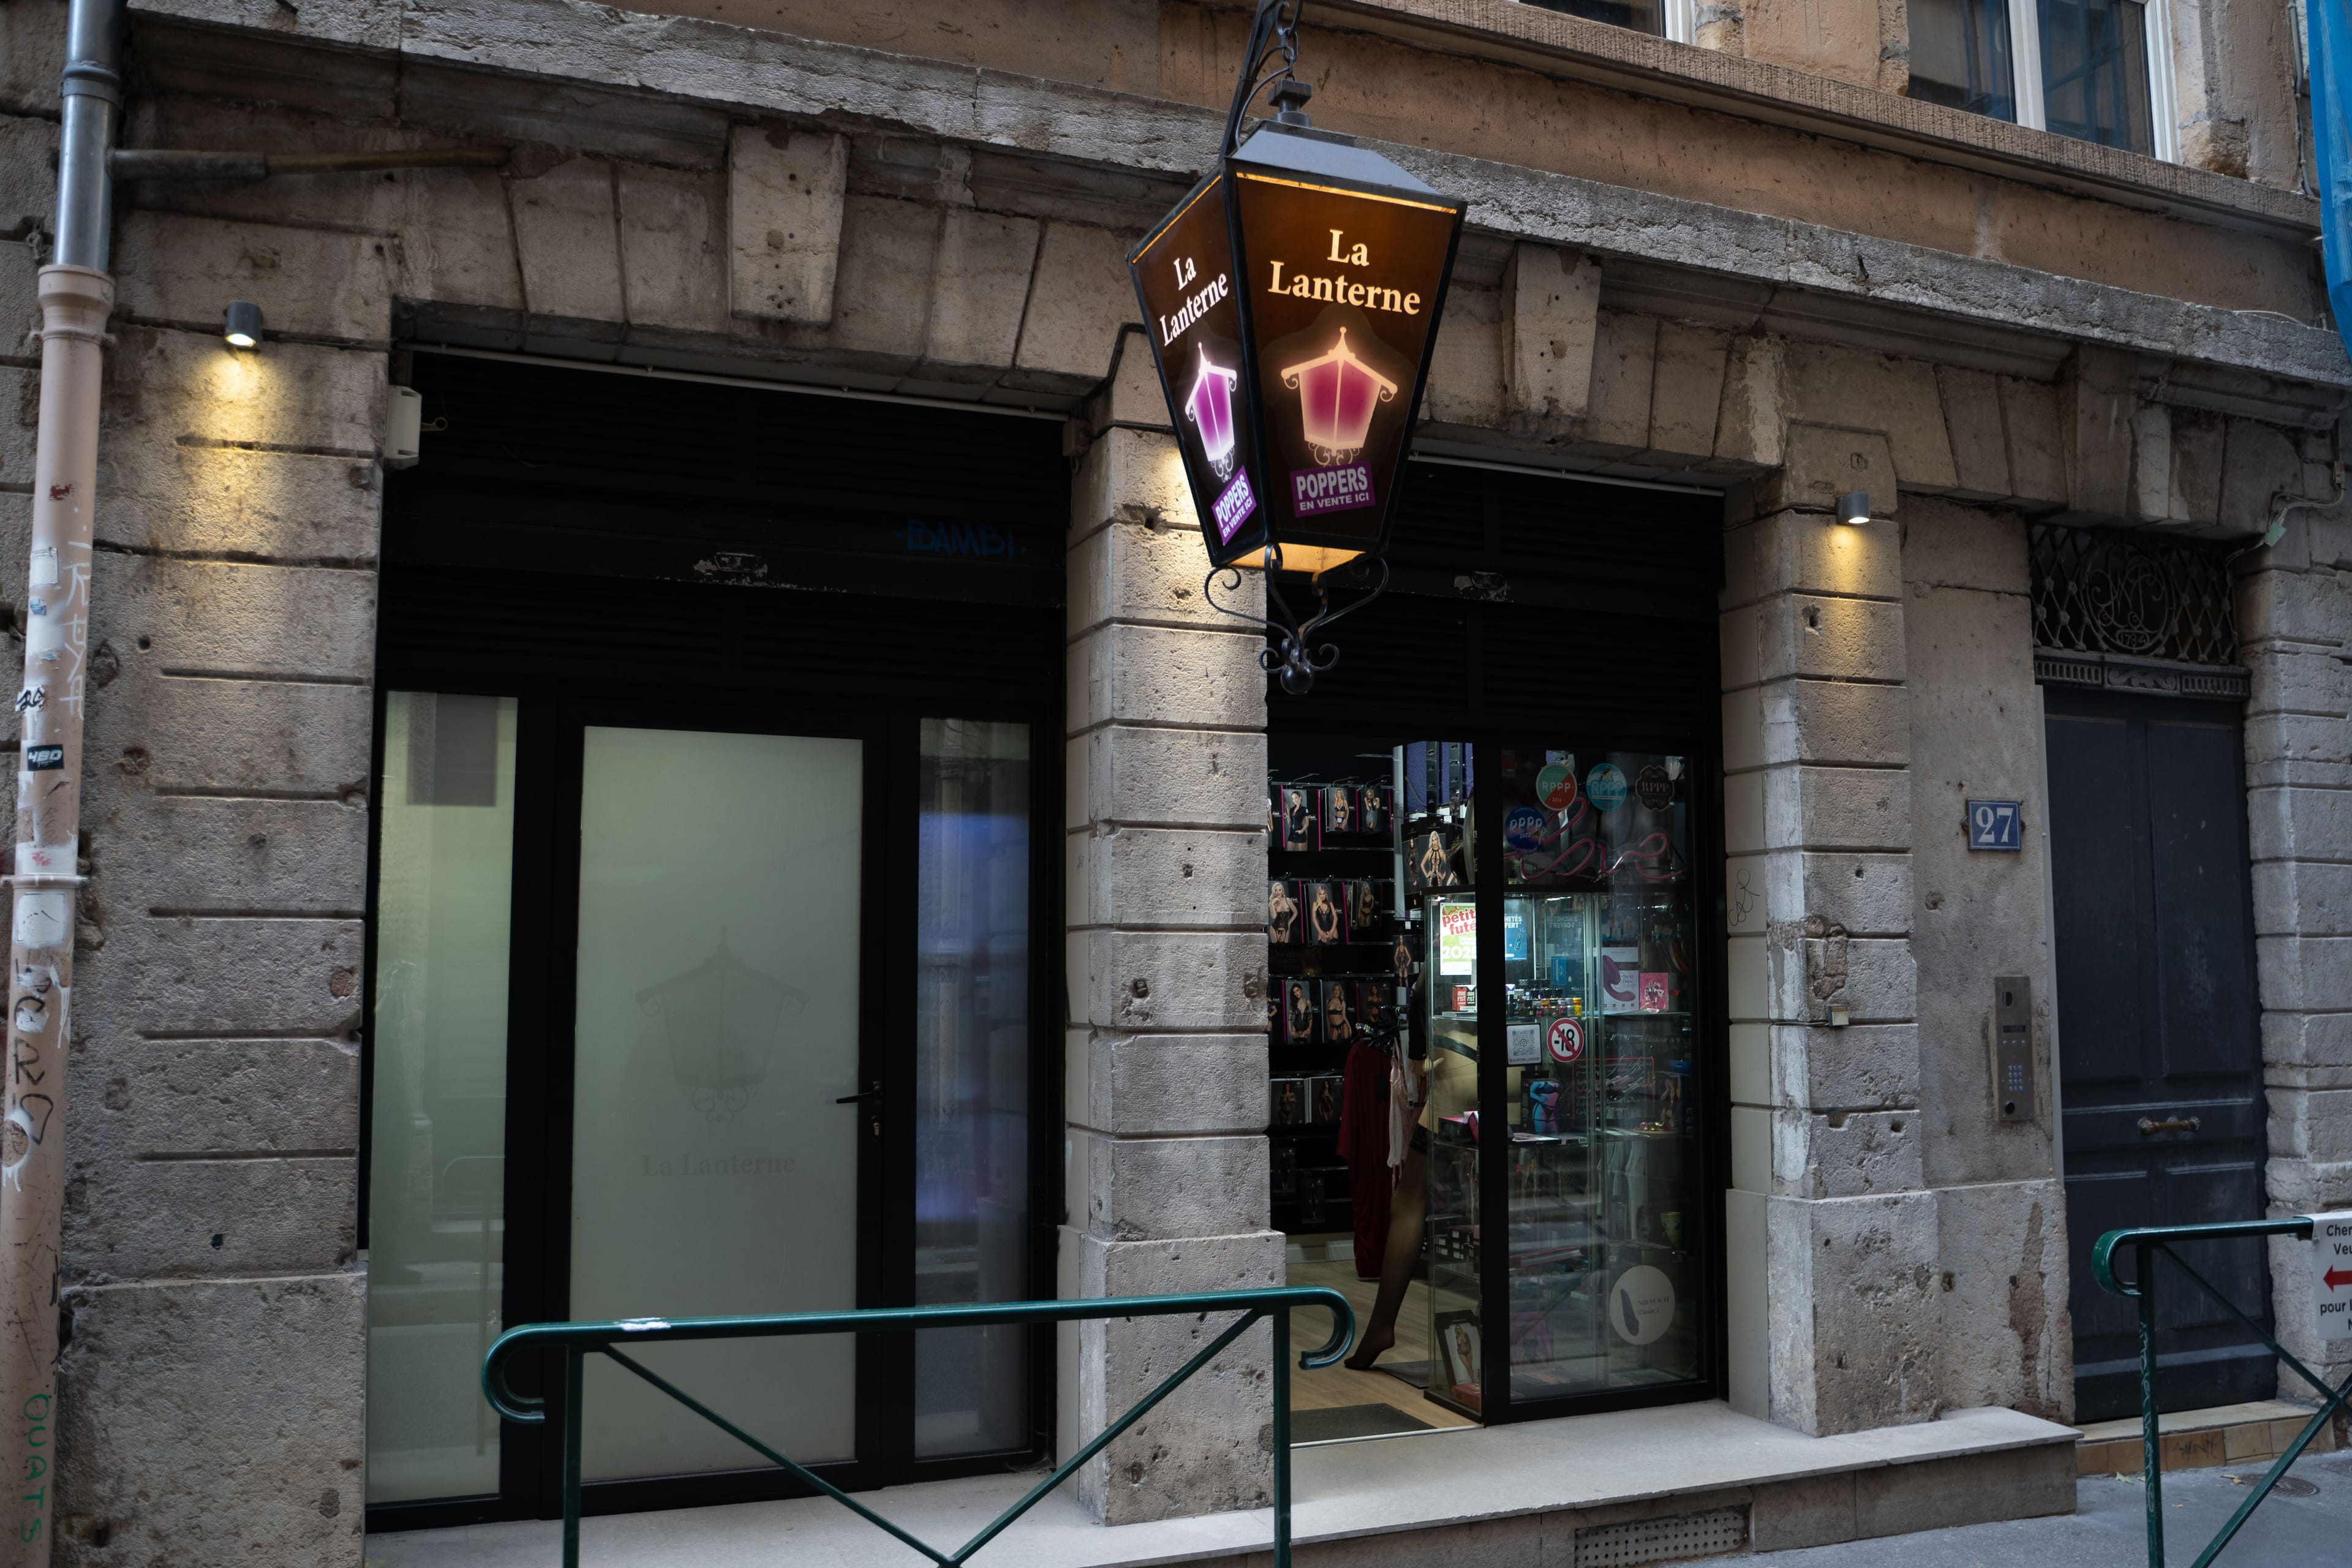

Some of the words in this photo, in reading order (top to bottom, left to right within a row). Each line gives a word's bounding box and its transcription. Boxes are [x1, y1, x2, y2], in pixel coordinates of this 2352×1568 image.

[1327, 229, 1369, 267] La
[1174, 257, 1197, 292] La
[1268, 260, 1420, 315] Lanterne
[1159, 273, 1229, 347] Lanterne
[1296, 466, 1368, 500] POPPERS
[1215, 474, 1249, 528] POPPERS
[1300, 500, 1314, 511] EN
[1317, 495, 1352, 508] VENTE
[1355, 492, 1369, 502] ICI
[1223, 524, 1231, 538] EN
[1229, 505, 1245, 528] VENTE
[1541, 781, 1571, 794] RPPP
[1591, 781, 1623, 796] RPPP
[1642, 782, 1668, 793] RPPP
[1509, 816, 1543, 833] RPPP
[1976, 807, 2013, 843] 27
[1442, 909, 1476, 927] petit
[1450, 921, 1476, 935] futé
[1554, 1028, 1575, 1052] -18
[641, 1154, 673, 1177] La
[681, 1153, 796, 1176] Lanterne
[2326, 1224, 2352, 1237] Cher
[2320, 1302, 2346, 1316] pour
